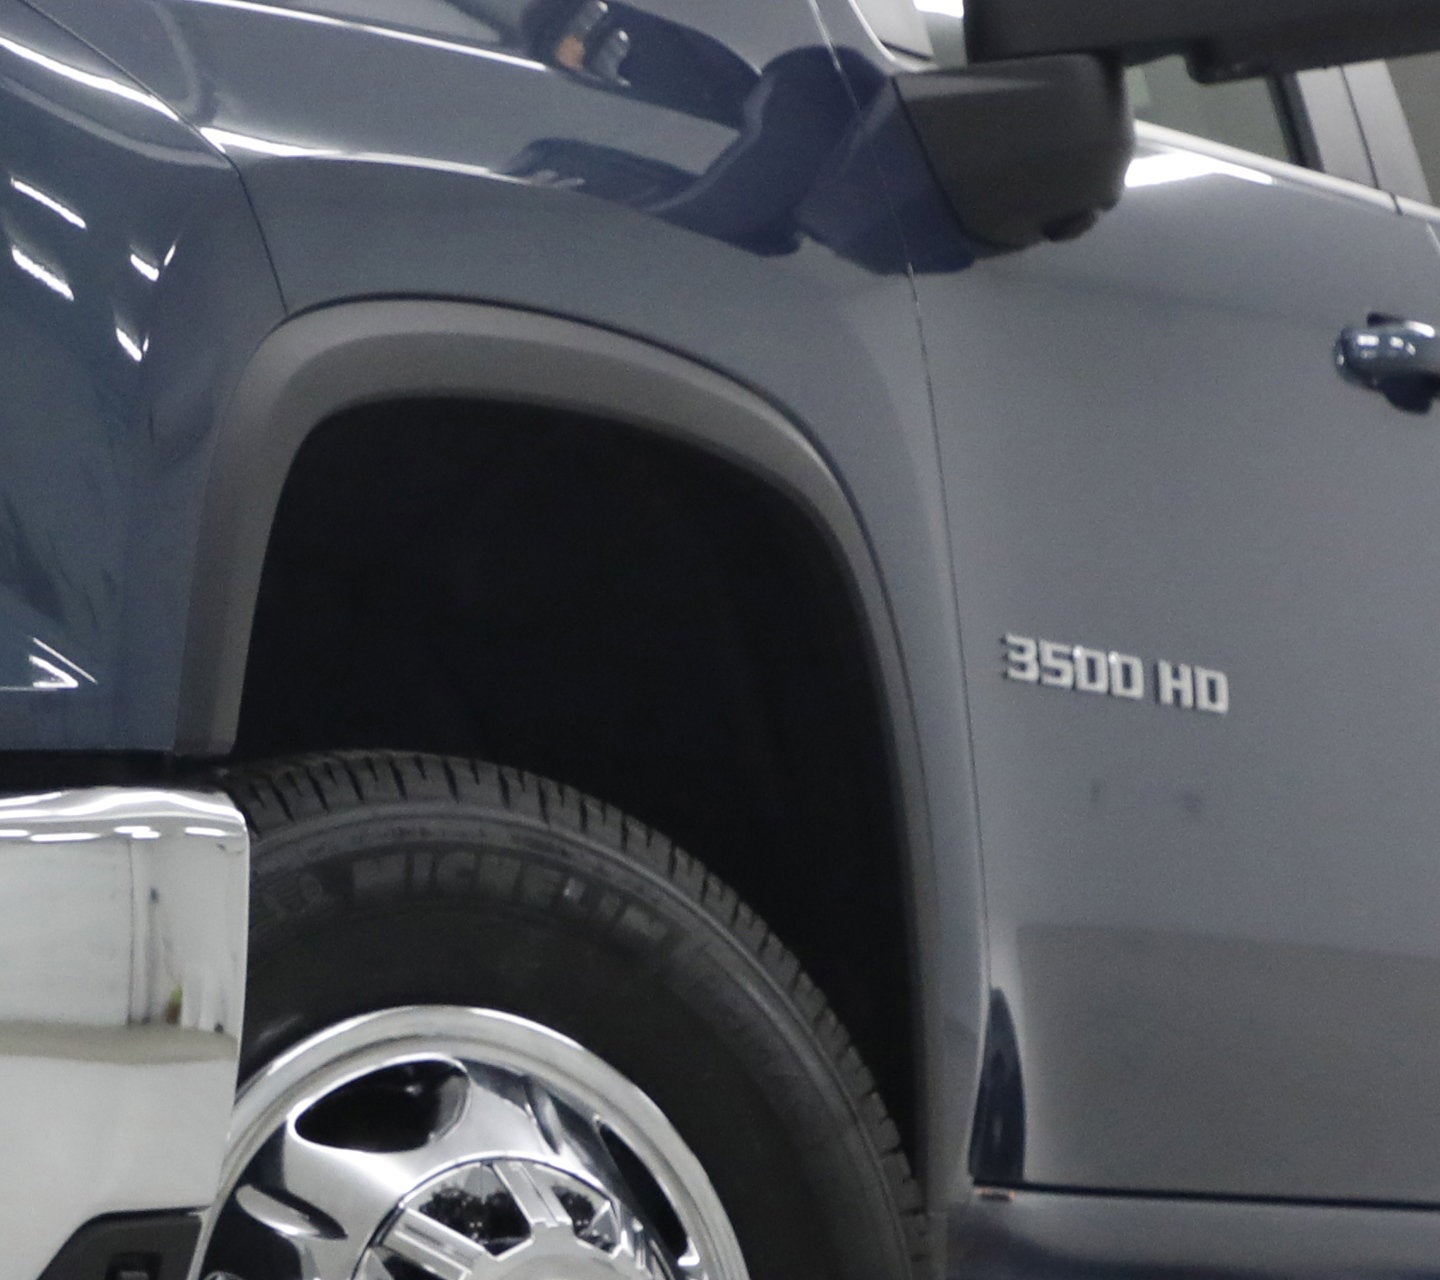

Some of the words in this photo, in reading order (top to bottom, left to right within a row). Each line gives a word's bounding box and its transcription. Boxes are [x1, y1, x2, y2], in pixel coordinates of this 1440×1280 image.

[1002, 632, 1144, 700] 3500
[1156, 658, 1229, 715] HD
[349, 847, 670, 942] MICHELIN
